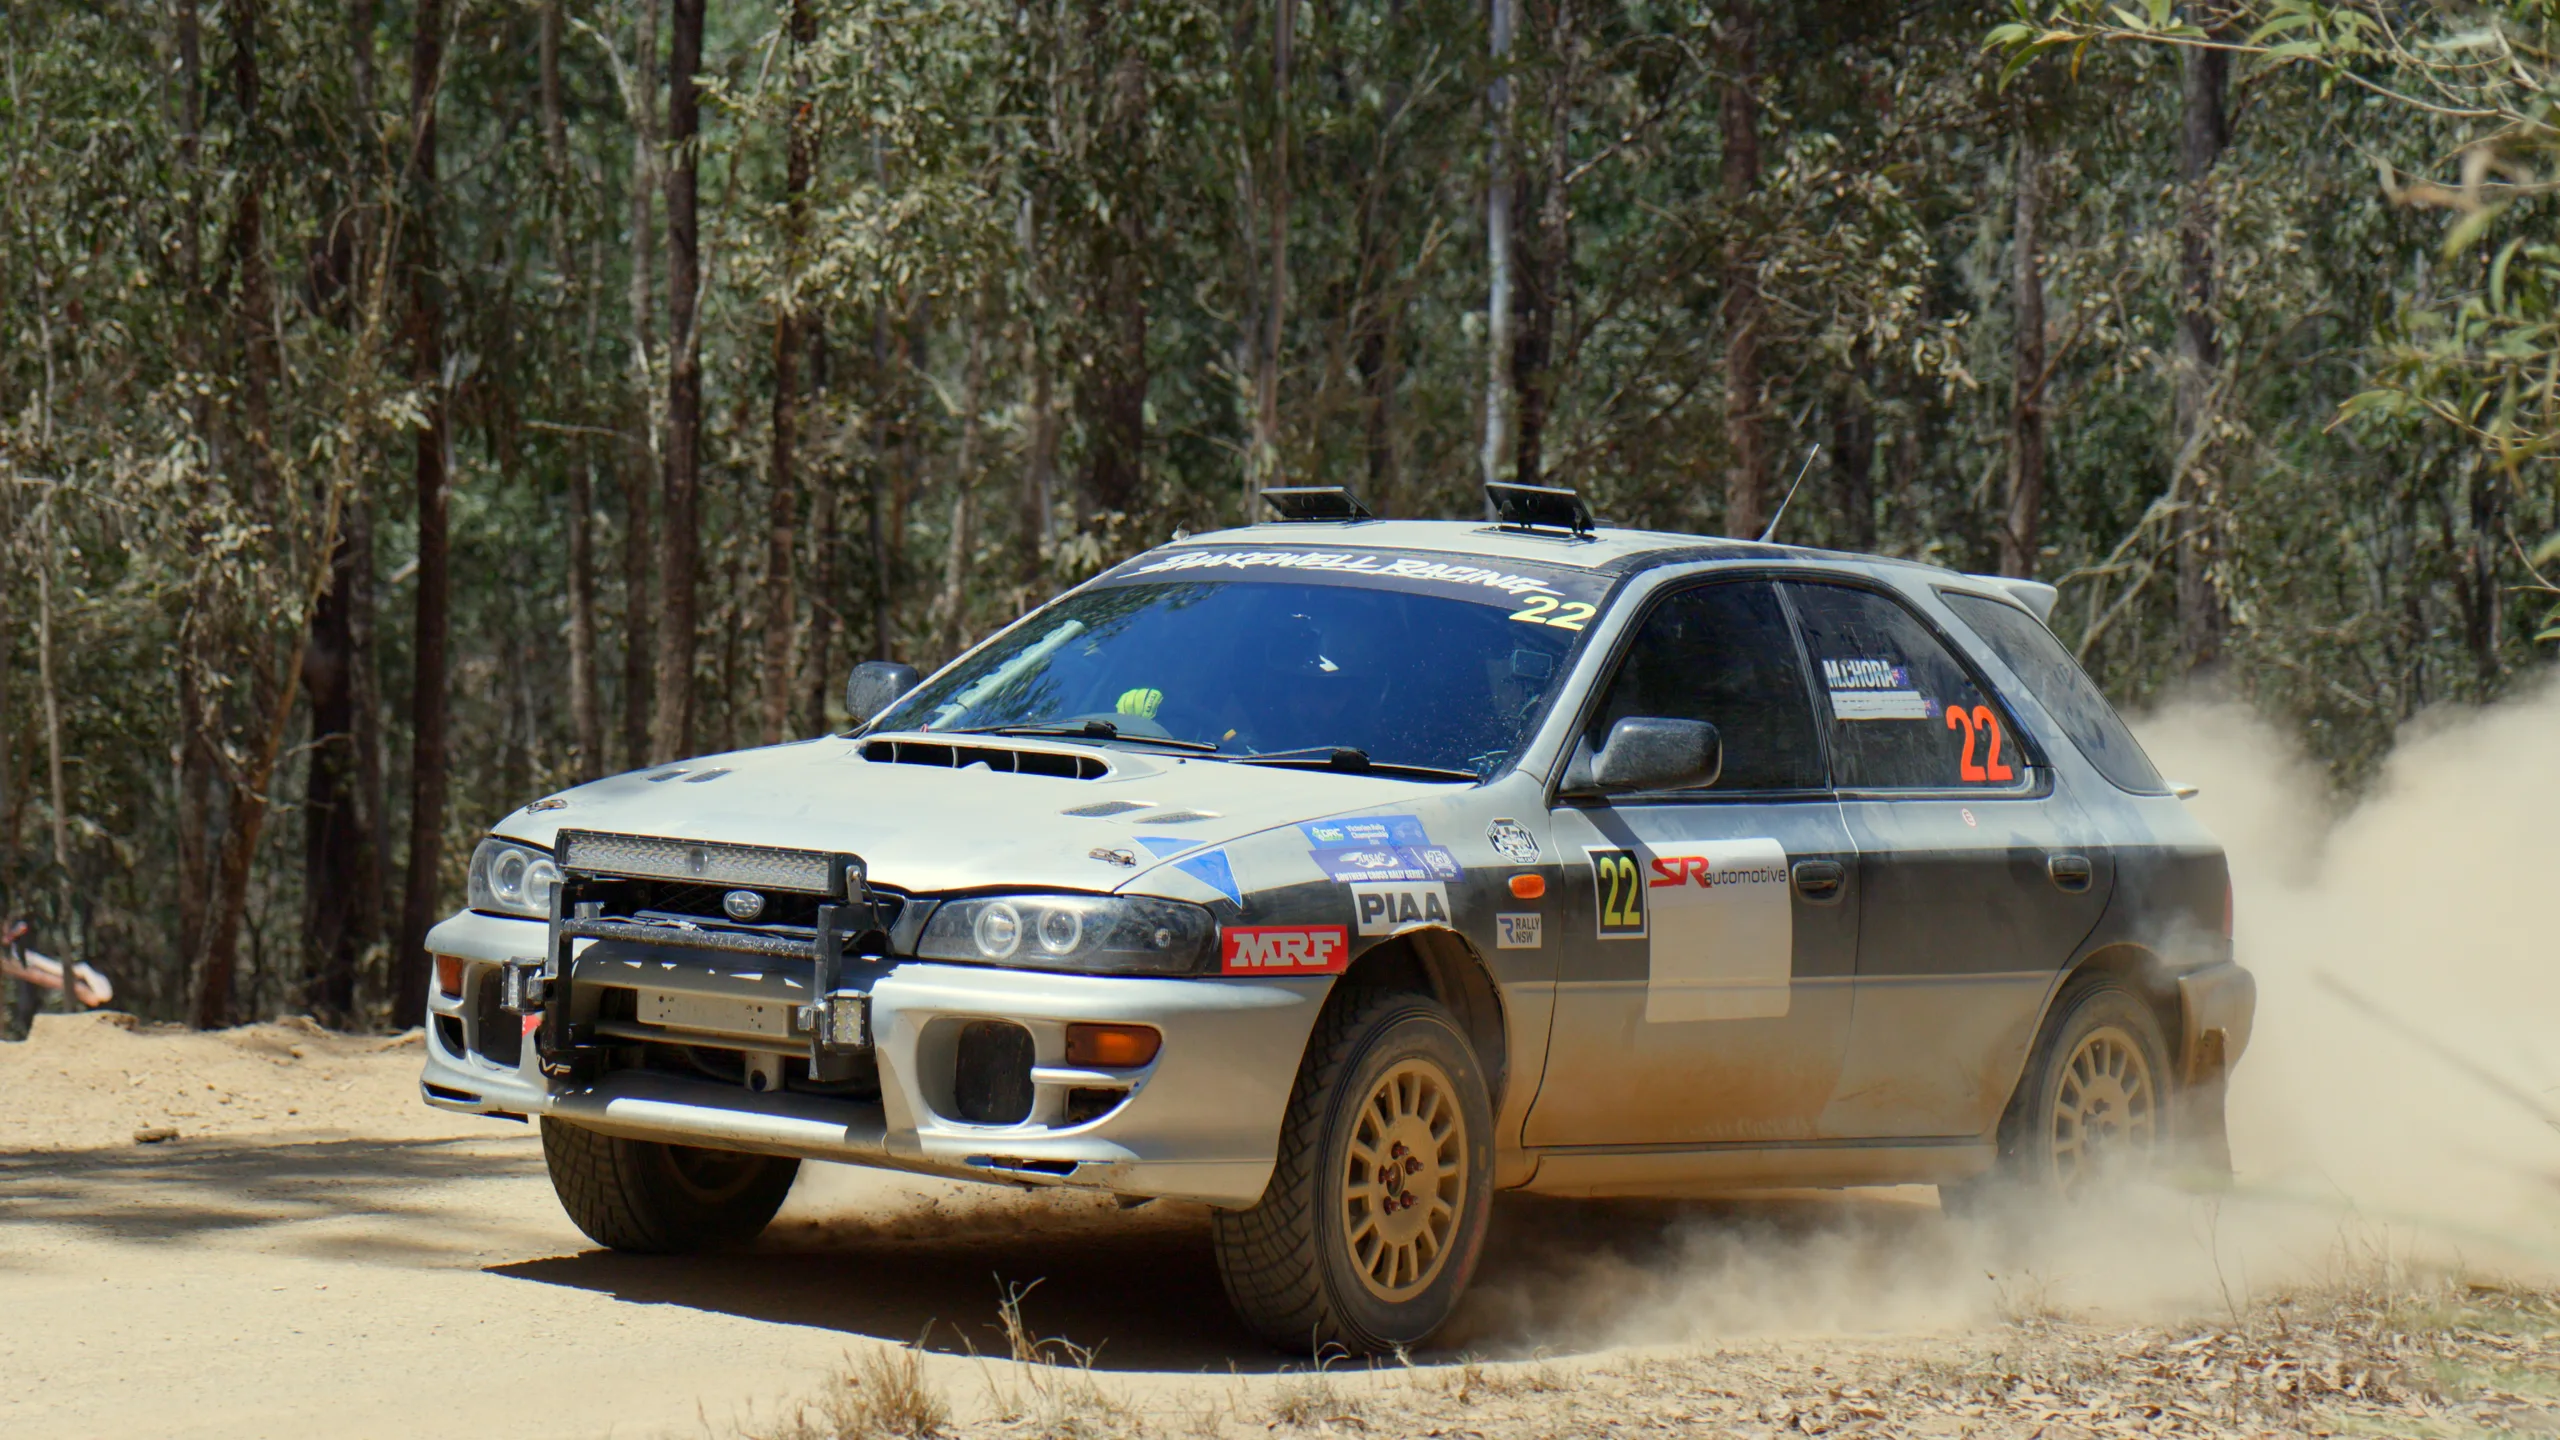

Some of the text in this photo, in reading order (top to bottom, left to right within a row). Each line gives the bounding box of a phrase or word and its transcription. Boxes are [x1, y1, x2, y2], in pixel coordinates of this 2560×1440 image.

[1377, 558, 1566, 596] RACING
[1509, 596, 1597, 631] 22
[1946, 705, 2013, 781] 22
[1335, 870, 1368, 882] SOUTHERN
[1367, 870, 1388, 880] CROSS
[1649, 856, 1787, 889] SR automotive
[1357, 892, 1448, 924] PIAA
[1600, 856, 1641, 926] 22
[1515, 917, 1540, 930] RALLY
[1515, 930, 1534, 944] NSW
[1230, 931, 1341, 968] MRF
